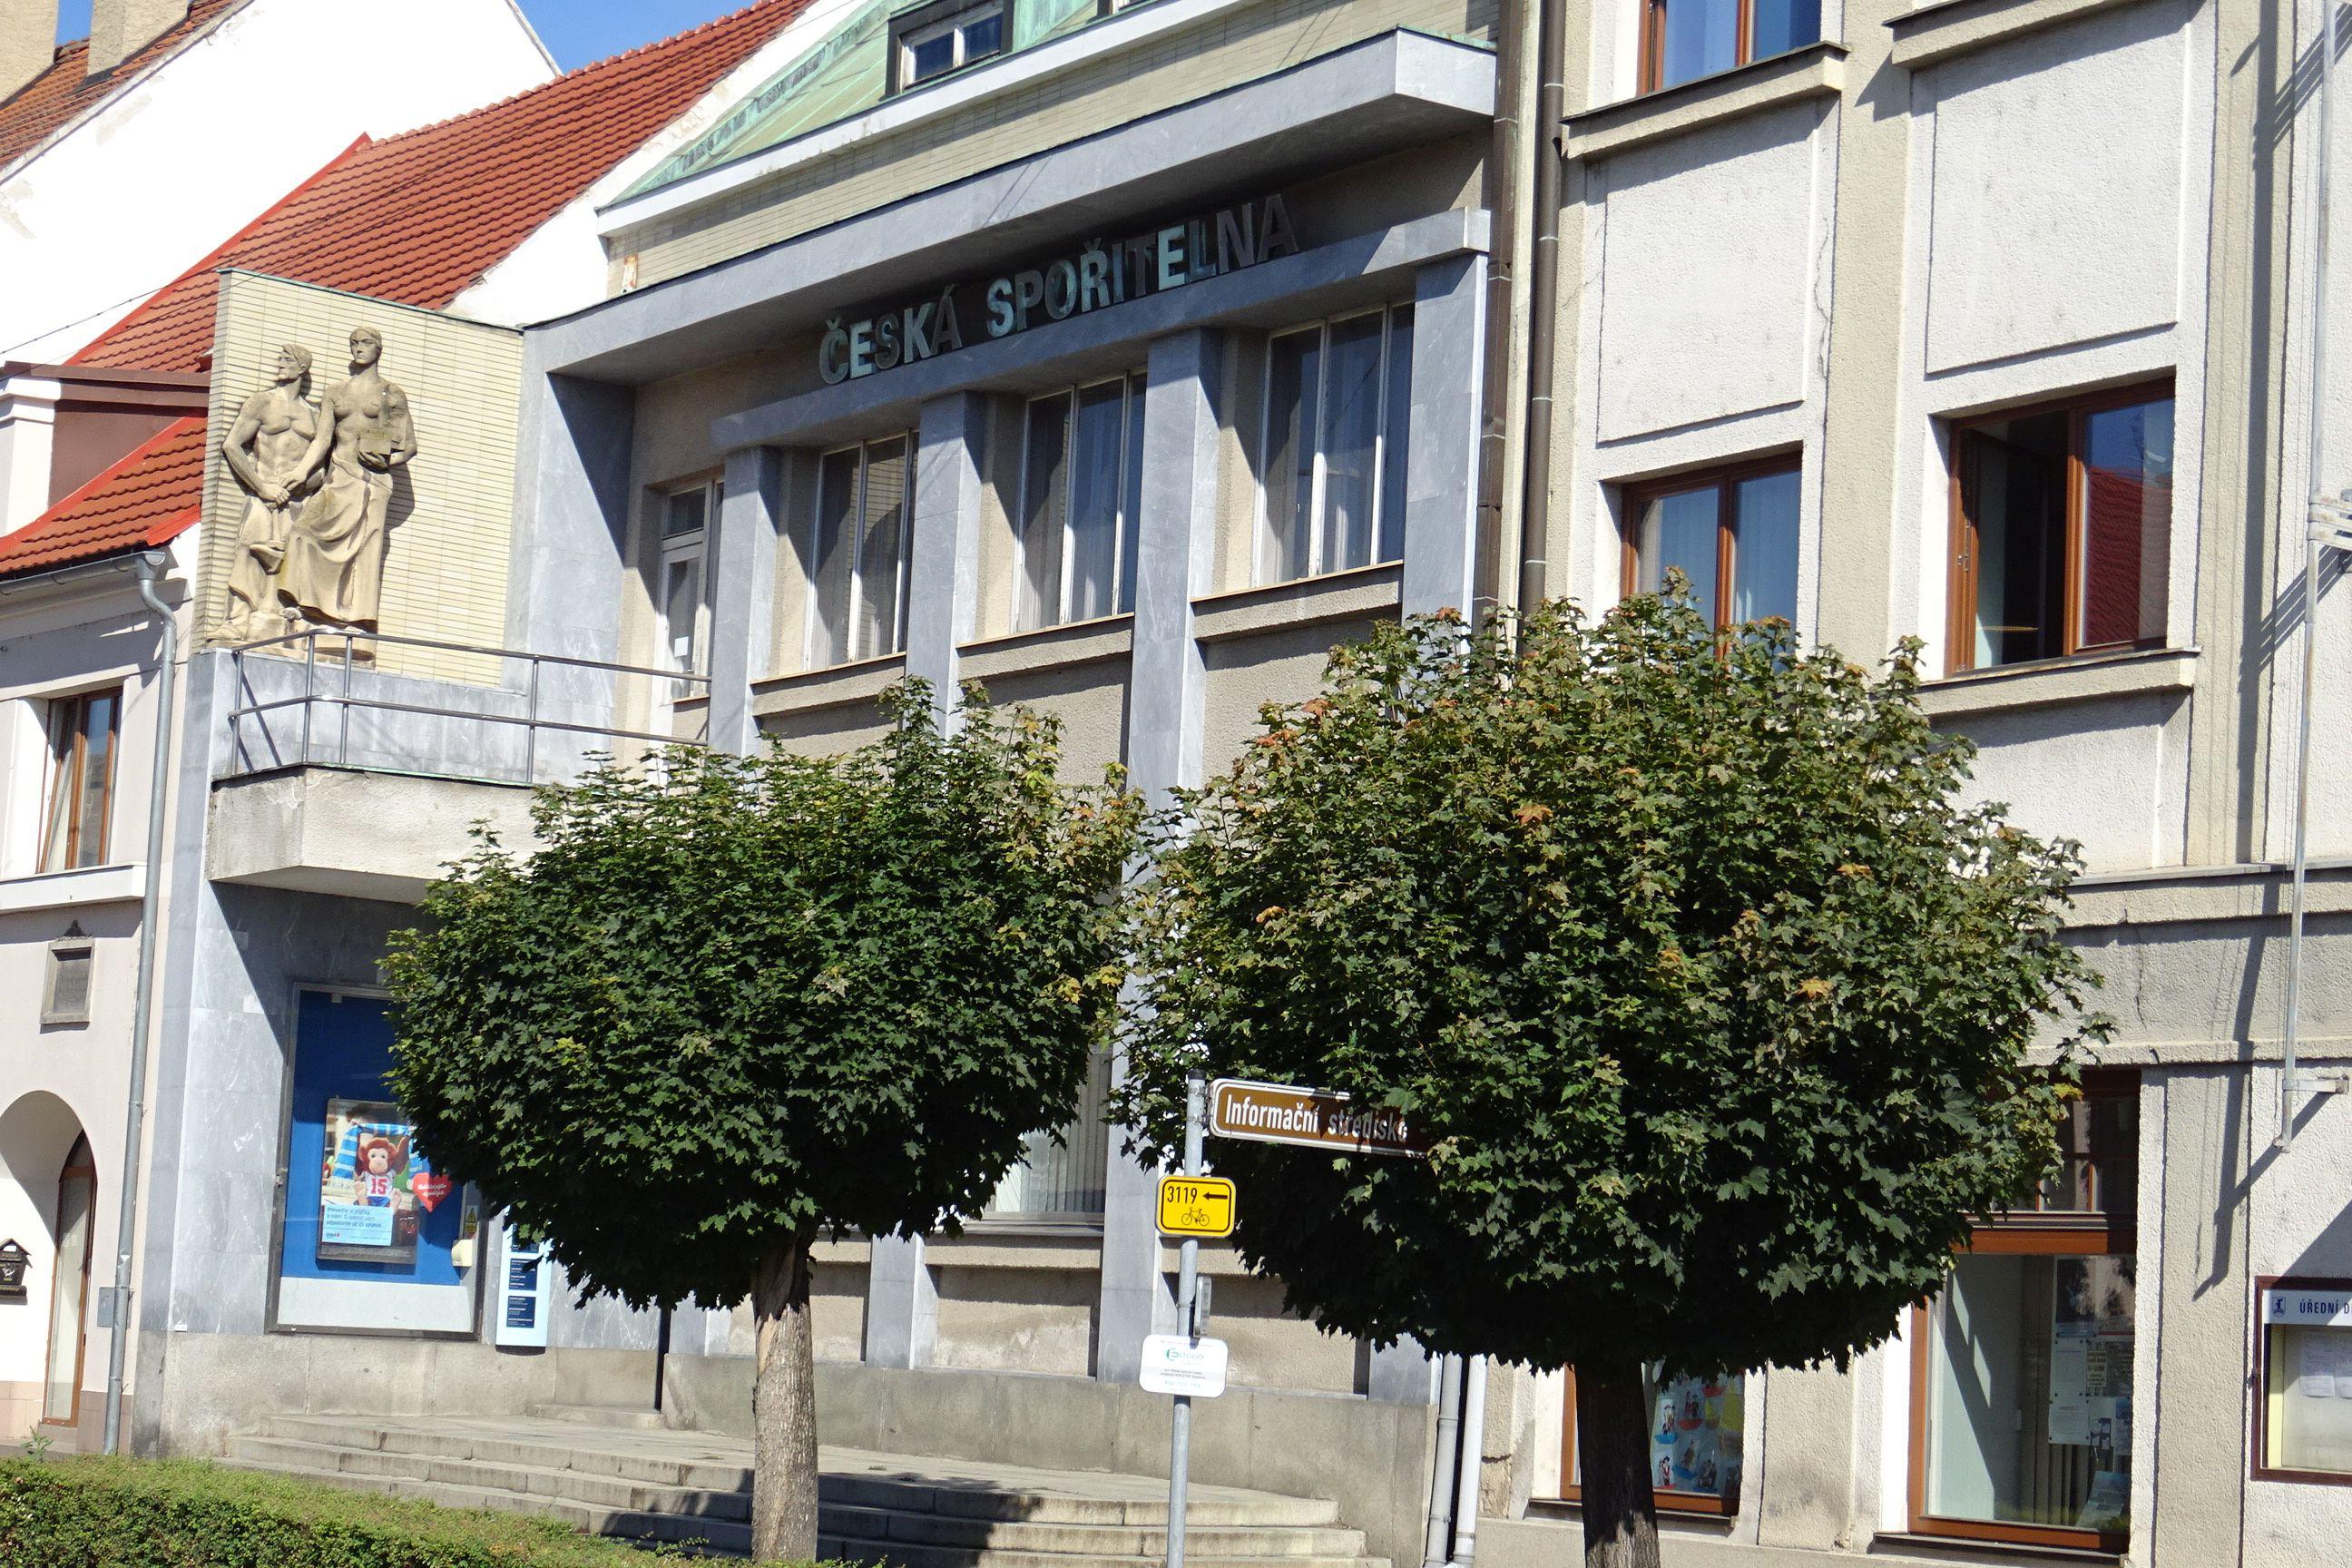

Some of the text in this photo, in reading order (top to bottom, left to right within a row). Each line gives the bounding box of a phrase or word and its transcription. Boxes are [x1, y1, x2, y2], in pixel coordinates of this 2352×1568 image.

[818, 193, 1299, 386] ČESKÁ SPOŘITELNA
[1225, 1093, 1320, 1133] Informační
[371, 1178, 387, 1195] 15
[1167, 1185, 1198, 1204] 3119
[2299, 1298, 2339, 1314] ÚŘEDNÍ
